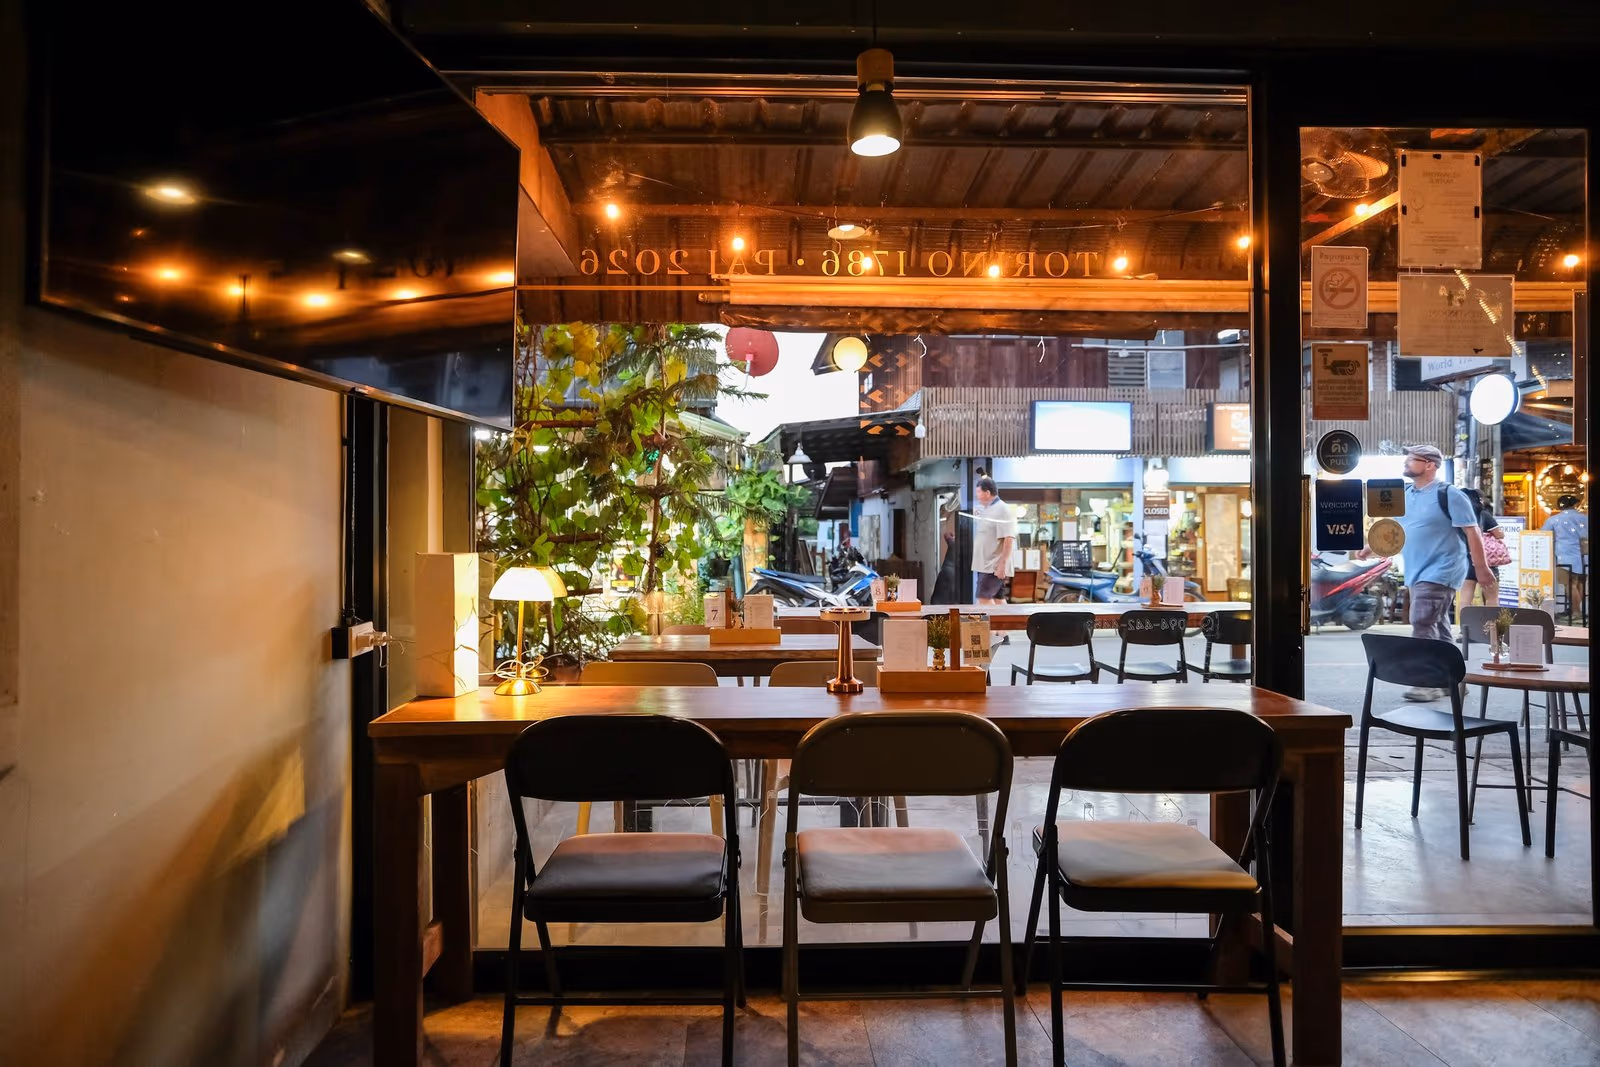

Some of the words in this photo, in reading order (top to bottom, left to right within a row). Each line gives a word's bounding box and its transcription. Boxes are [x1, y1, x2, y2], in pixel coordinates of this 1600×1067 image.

[1428, 358, 1453, 371] World
[1330, 458, 1350, 466] PULL
[1320, 500, 1359, 509] Welcome
[1144, 507, 1168, 515] CLOSED
[1326, 523, 1355, 535] VISA
[711, 609, 718, 621] 7
